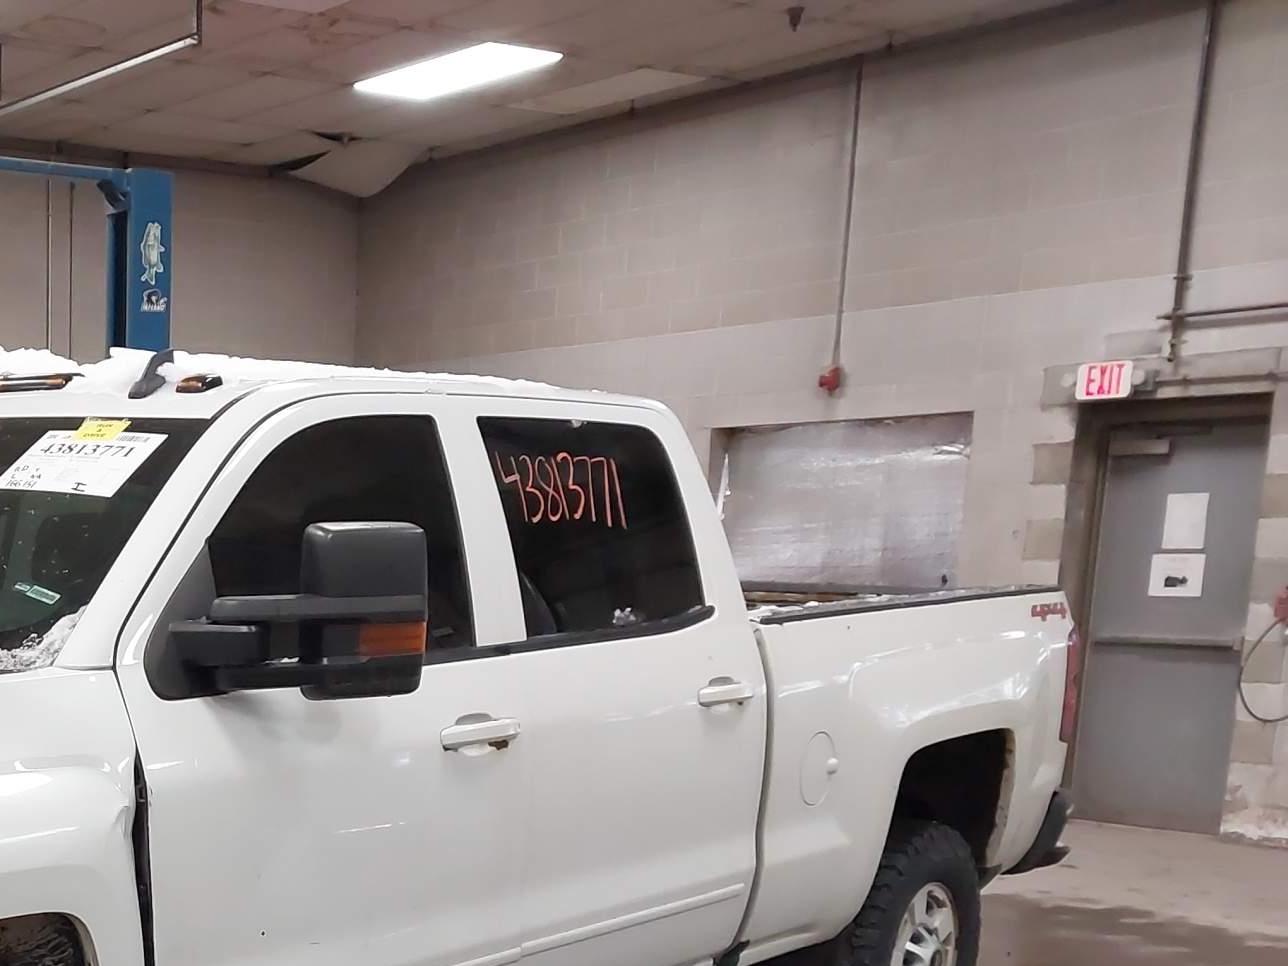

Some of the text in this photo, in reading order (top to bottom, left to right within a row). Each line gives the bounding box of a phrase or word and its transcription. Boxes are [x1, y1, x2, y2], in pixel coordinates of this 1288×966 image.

[1085, 363, 1126, 396] EXIT
[40, 443, 136, 457] 43813771
[495, 450, 628, 530] 43813771
